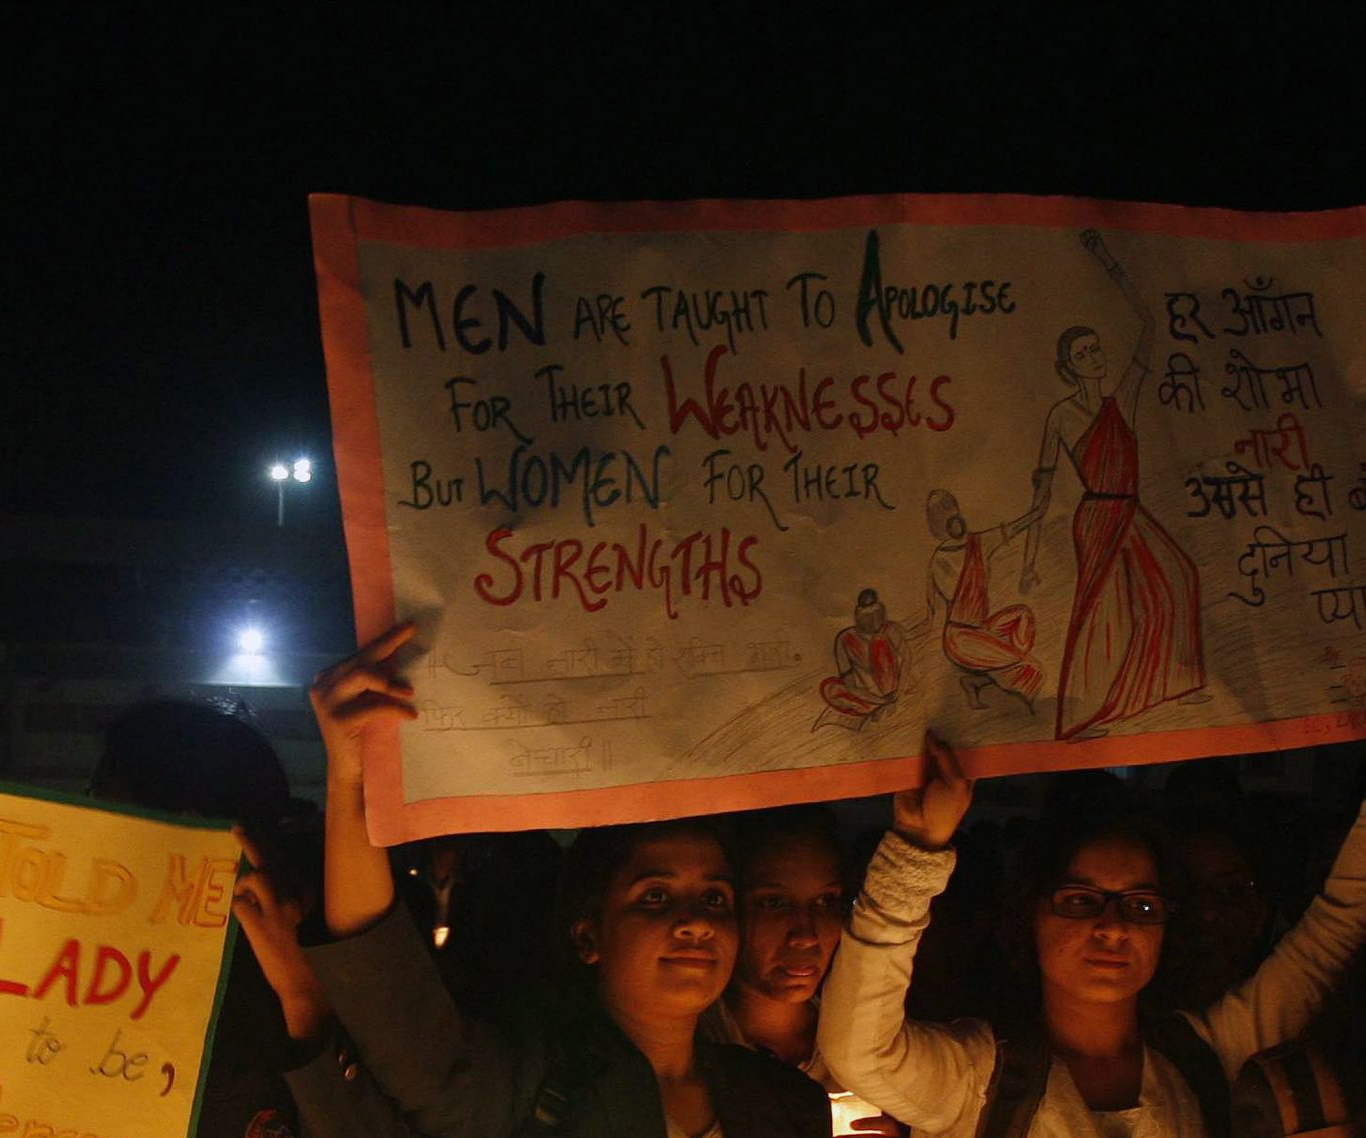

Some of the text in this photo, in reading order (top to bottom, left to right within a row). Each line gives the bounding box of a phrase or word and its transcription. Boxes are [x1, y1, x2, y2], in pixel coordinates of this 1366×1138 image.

[393, 229, 1017, 355] MEN ARE TAUGHT TO APOLOGISE
[1164, 290, 1215, 344] हर
[444, 343, 957, 453] FOR THEIR WEAKNESSES
[1158, 352, 1208, 414] की
[1236, 412, 1309, 471] नारी
[399, 445, 897, 531] BUT WOMEN FOR THEIR
[1294, 466, 1335, 522] ही
[473, 523, 764, 619] STRENGTHS
[1227, 525, 1352, 607] दुनिया
[148, 853, 239, 928] ME
[25, 1013, 64, 1066] to
